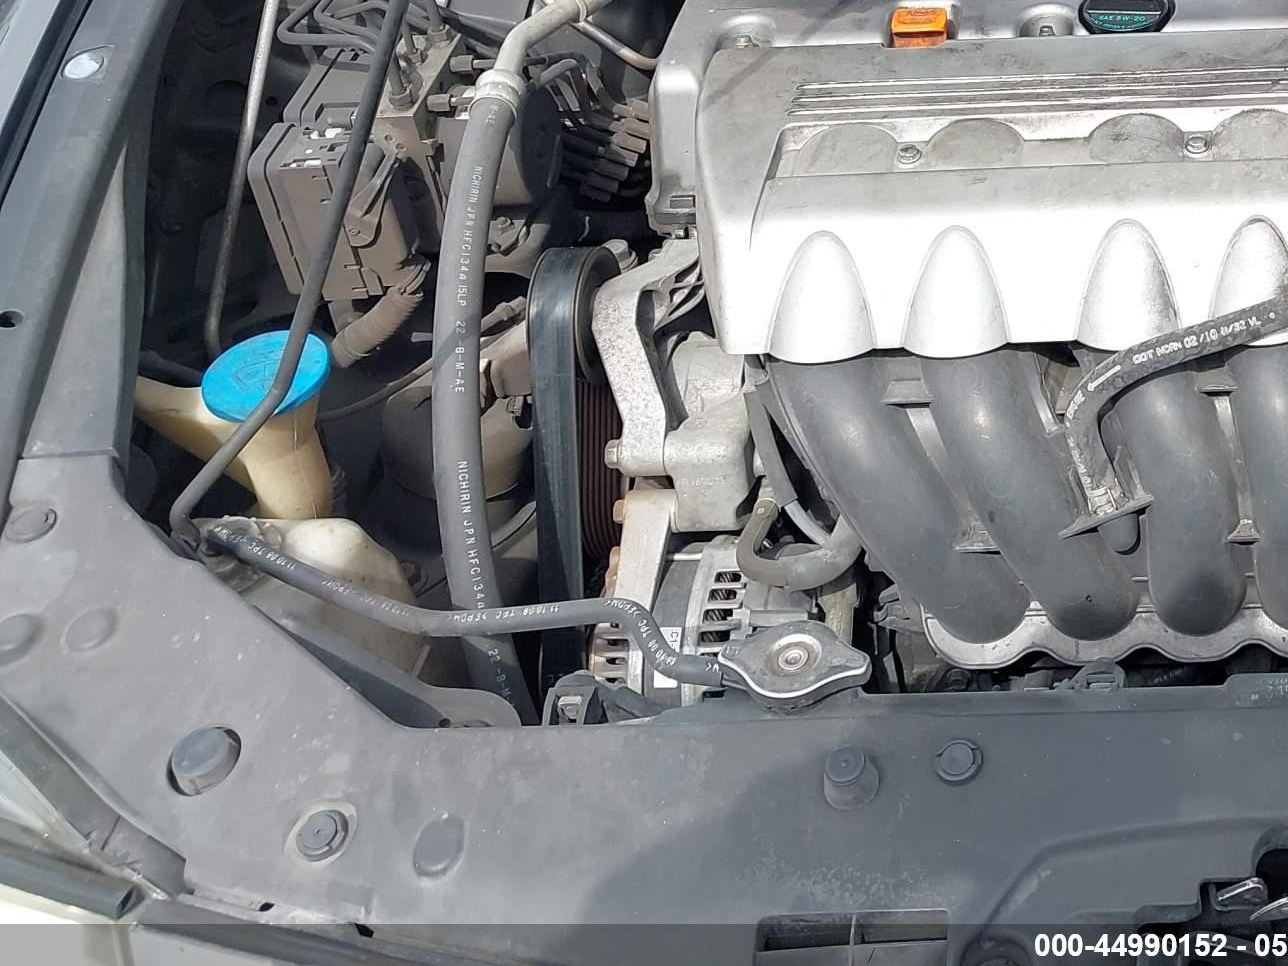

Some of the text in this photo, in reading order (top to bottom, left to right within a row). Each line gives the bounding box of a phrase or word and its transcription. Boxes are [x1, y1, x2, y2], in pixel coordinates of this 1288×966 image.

[469, 166, 484, 203] NICHIRIN
[465, 207, 475, 226] JPN
[457, 461, 473, 513] NICHIRIN
[463, 519, 476, 545] JPN
